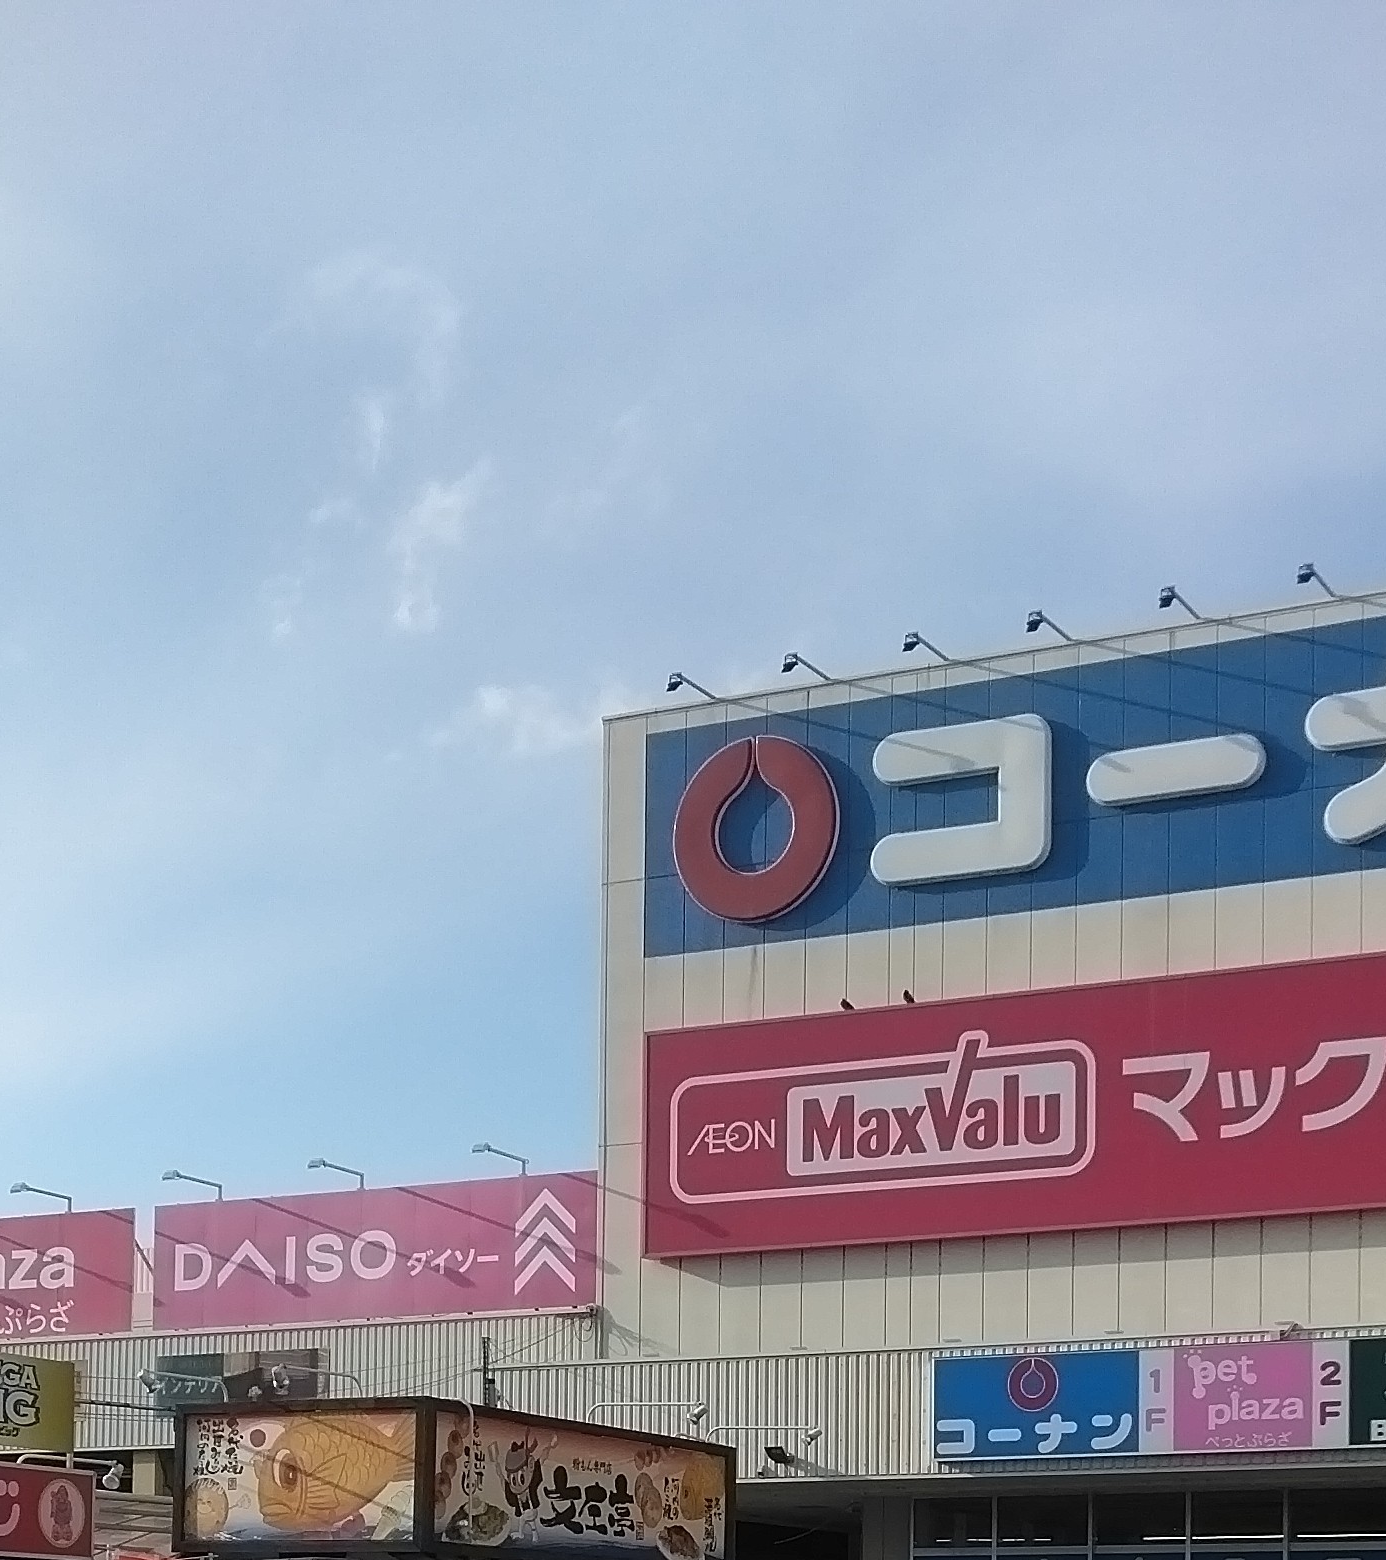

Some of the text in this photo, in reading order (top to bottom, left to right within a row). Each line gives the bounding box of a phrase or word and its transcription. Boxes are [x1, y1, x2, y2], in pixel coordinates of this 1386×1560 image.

[803, 1038, 1060, 1165] MaxValu
[174, 1229, 499, 1291] DAISO ダイソー
[1186, 1353, 1257, 1399] pet
[1207, 1389, 1304, 1430] plaza
[936, 1413, 1133, 1455] コーナン
[1205, 1431, 1294, 1448] ぺっとぷらざ
